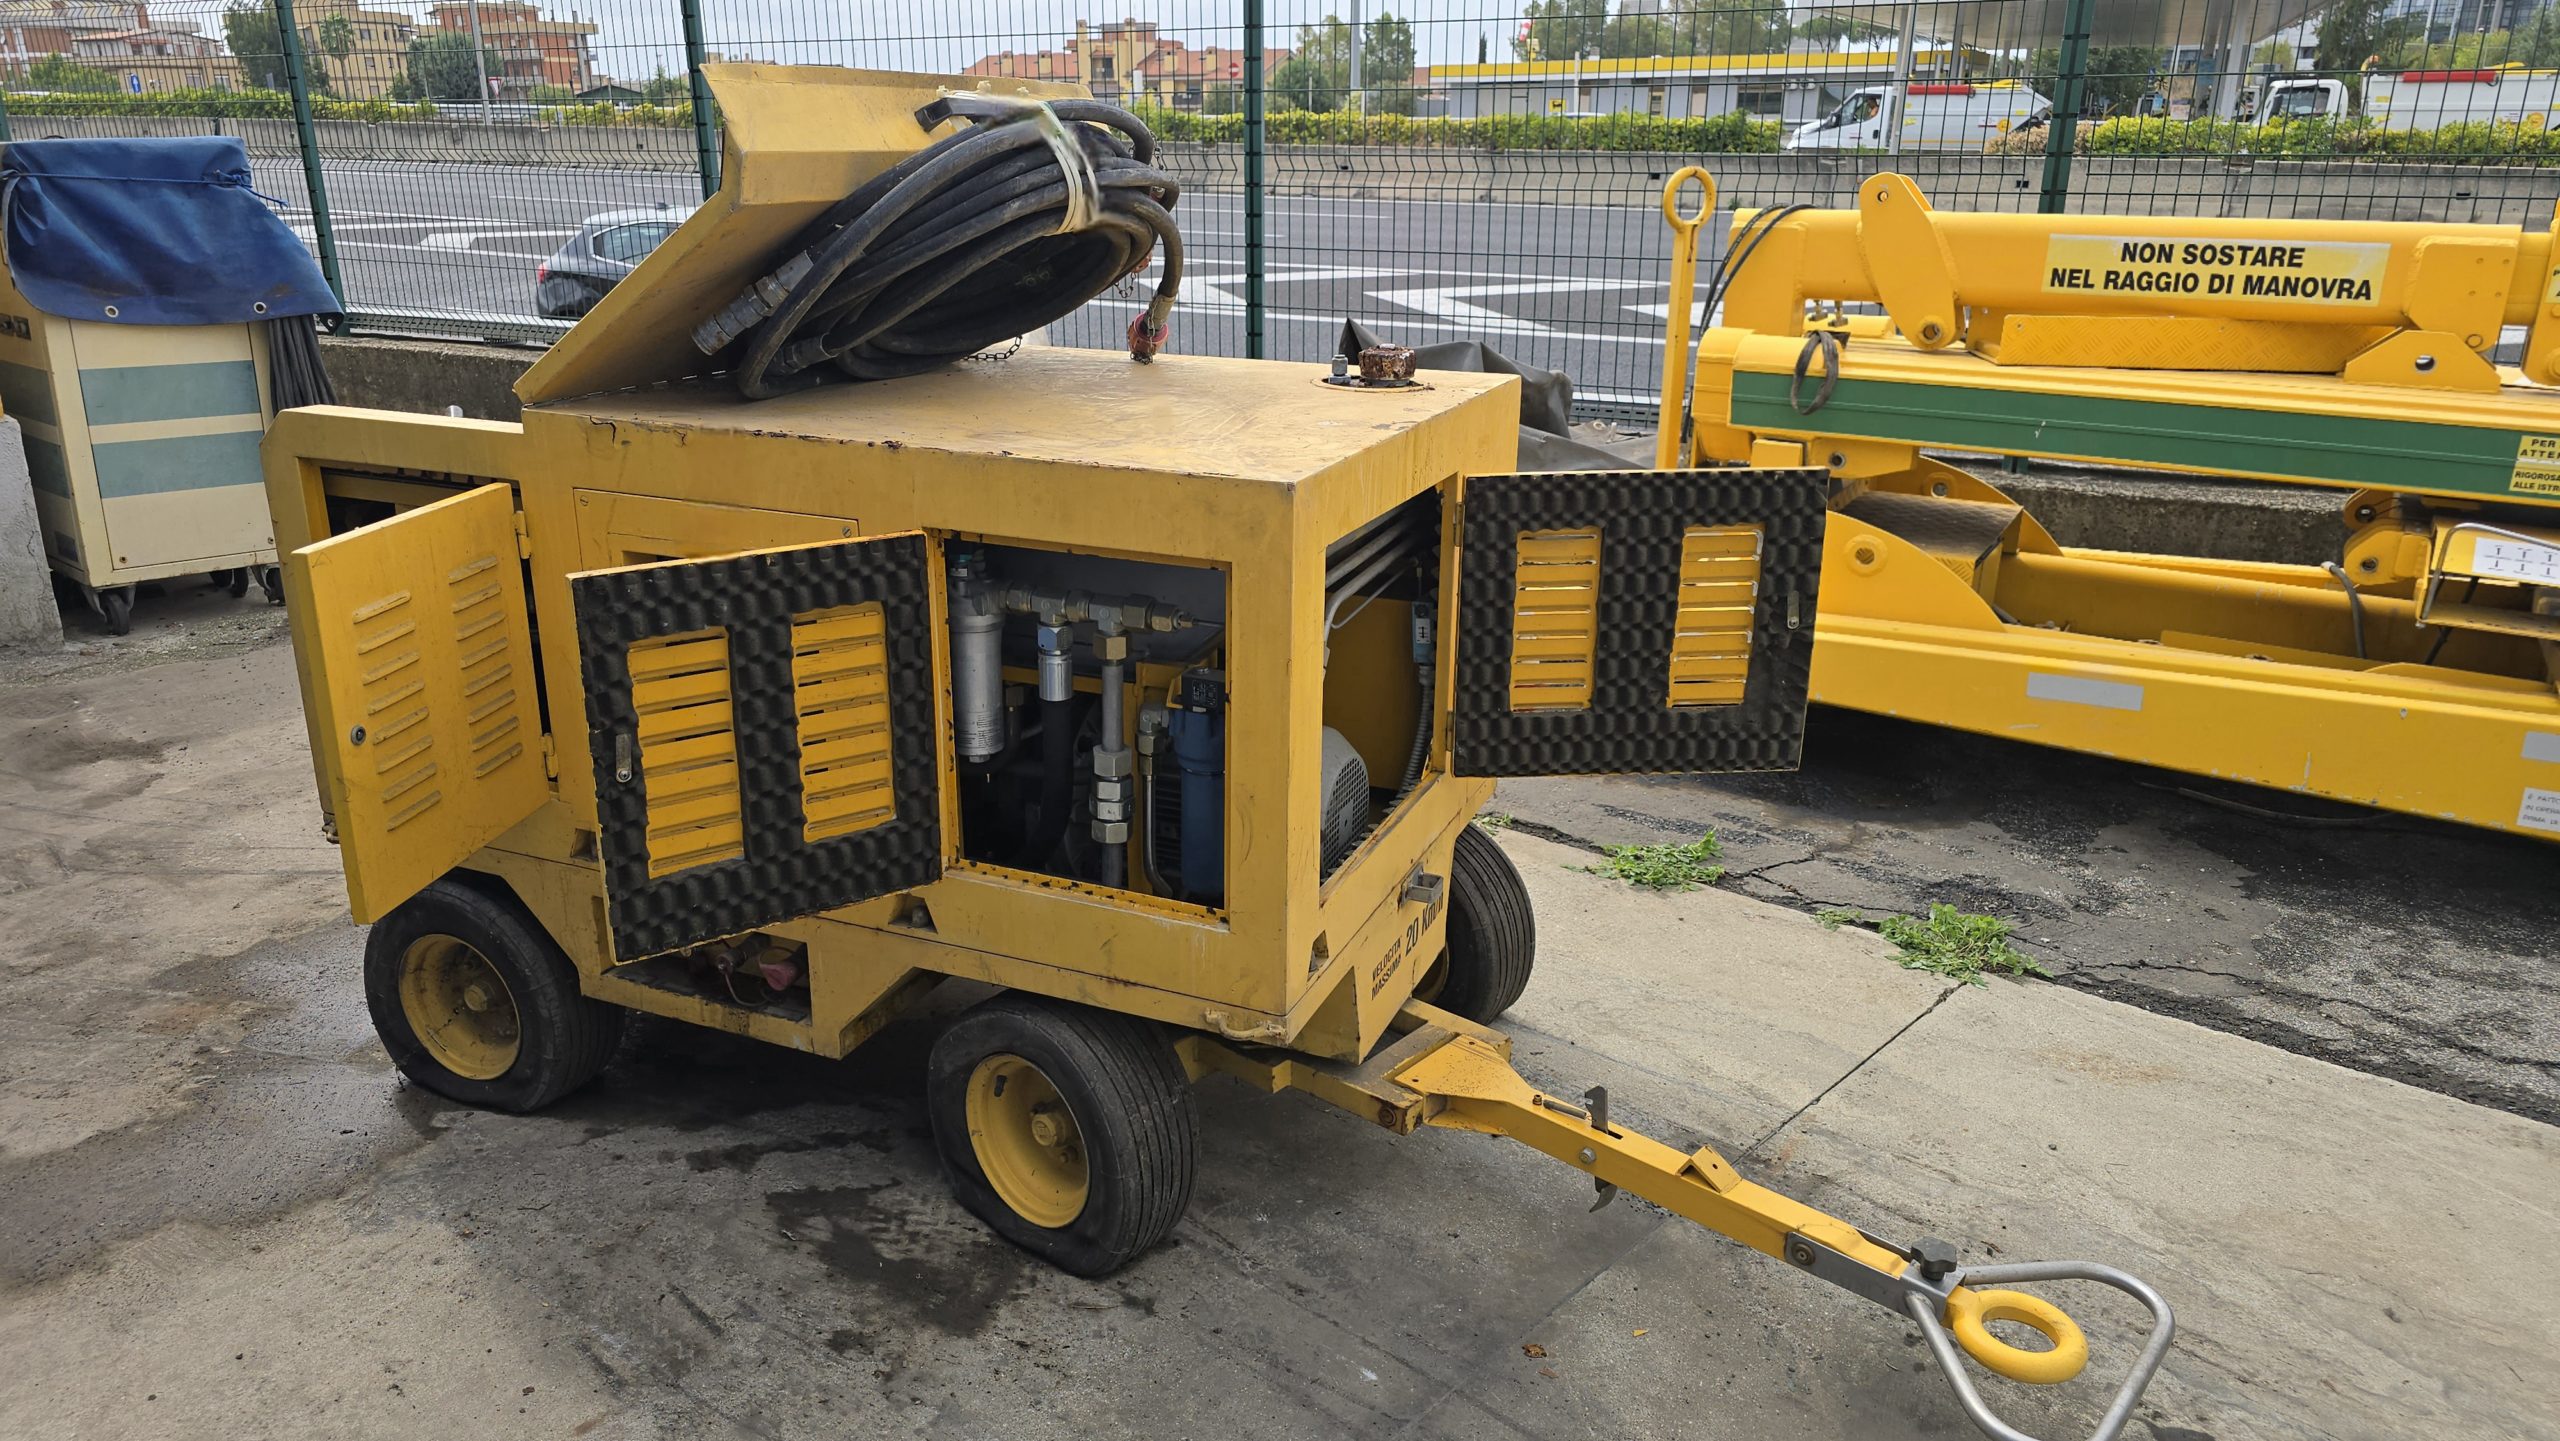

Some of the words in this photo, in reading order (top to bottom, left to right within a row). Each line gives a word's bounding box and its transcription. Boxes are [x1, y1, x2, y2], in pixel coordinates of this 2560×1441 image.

[2121, 242, 2174, 264] NON
[2182, 244, 2305, 268] SOSTARE
[2050, 268, 2095, 290] NEL
[2103, 270, 2199, 293] RAGGIO
[2208, 274, 2235, 295] DI
[2242, 275, 2372, 300] MANOVRA
[2531, 438, 2556, 448] PER
[2513, 481, 2536, 490] ALLE
[1405, 915, 1419, 957] 20
[1371, 953, 1402, 1001] MASSIMA
